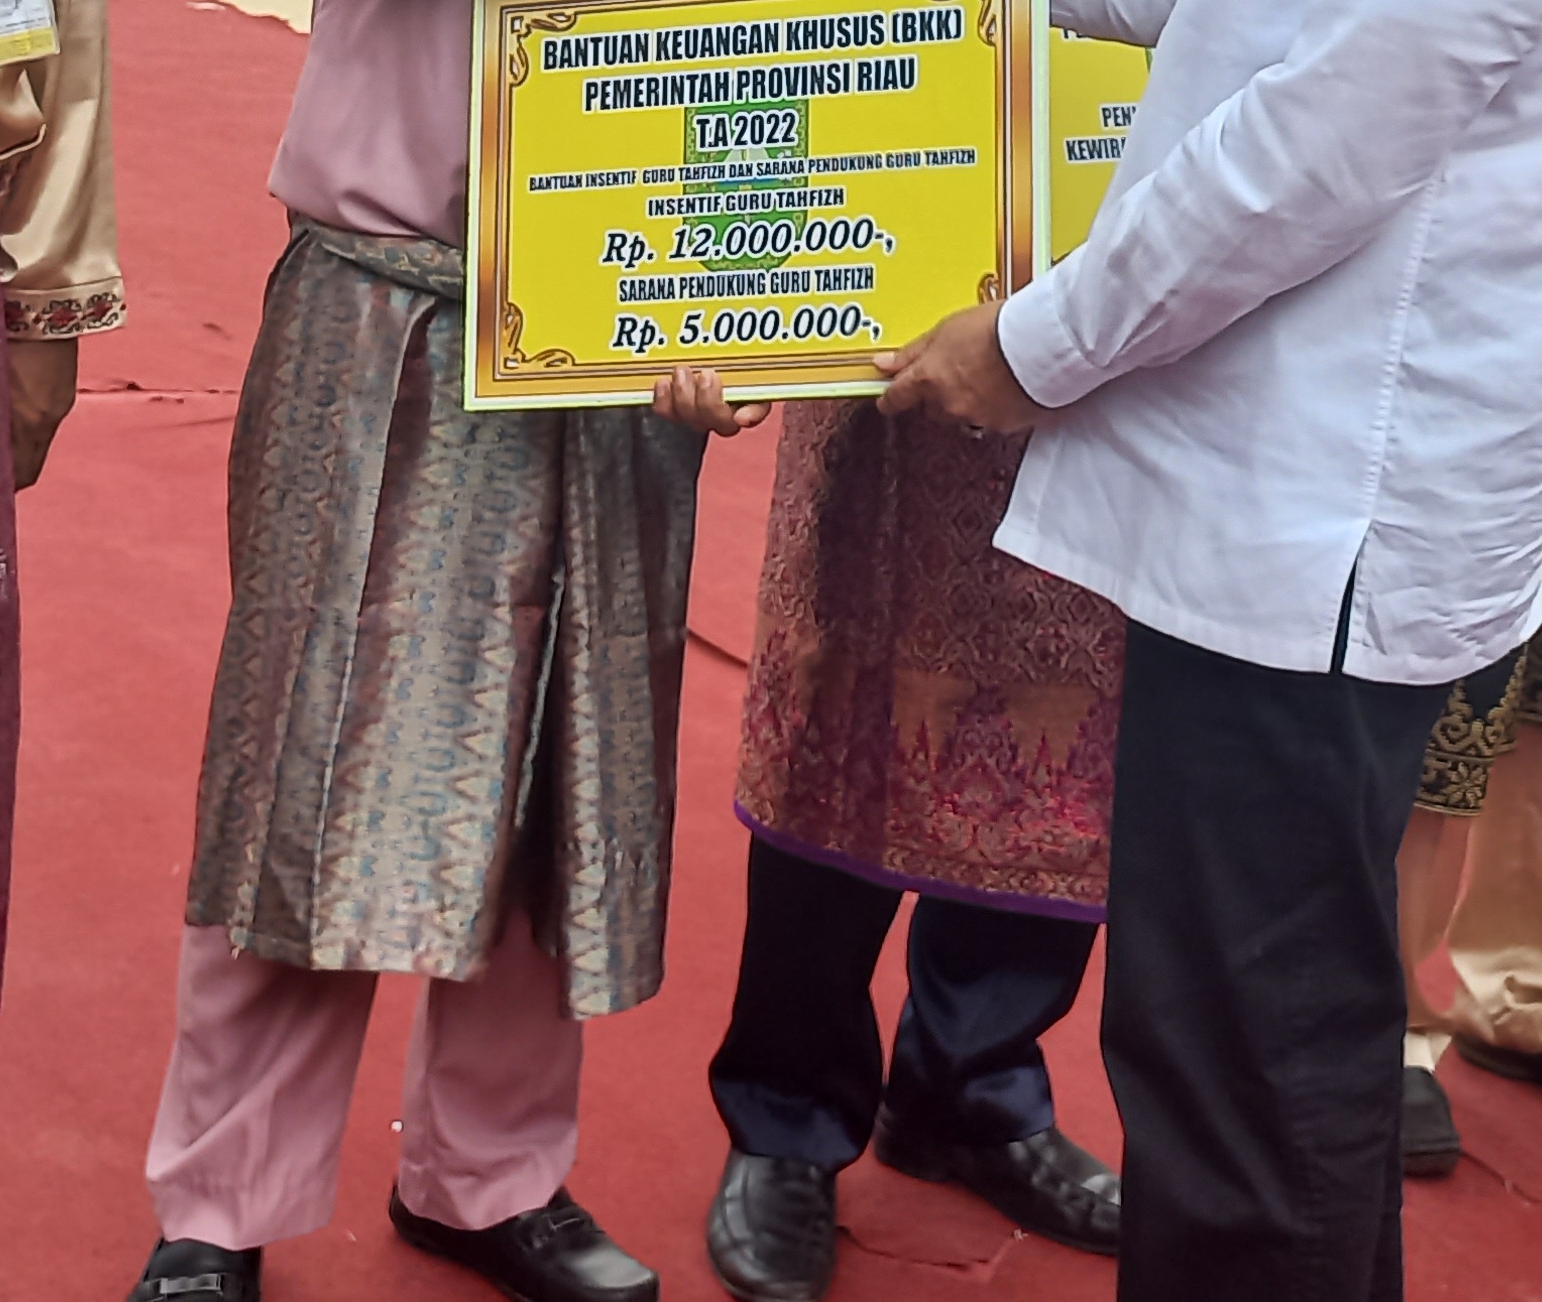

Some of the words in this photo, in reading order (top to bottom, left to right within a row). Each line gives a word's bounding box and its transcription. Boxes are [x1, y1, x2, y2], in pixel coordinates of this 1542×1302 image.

[543, 33, 649, 70] BANTUAN
[656, 22, 779, 61] KEUANGAN
[786, 15, 885, 51] KHUSUS
[892, 9, 962, 43] (BKK)
[585, 71, 729, 111] PEMERINTAH
[736, 62, 850, 100] PROVINSI
[857, 58, 915, 92] RIAU
[734, 112, 796, 146] 2022
[529, 175, 583, 191] BANTUAN
[586, 170, 637, 186] INSENTIF
[642, 168, 674, 183] GURU
[678, 164, 726, 180] TAHFIZH
[729, 164, 753, 178] DAN
[757, 160, 804, 176] SARANA
[808, 153, 882, 173] PENDUKUNG
[886, 151, 920, 168] GURU
[925, 149, 975, 165] TAHFIZH
[648, 196, 721, 216] INSENTIF
[725, 194, 772, 211] GURU
[776, 188, 844, 208] TAHFIZH
[602, 233, 654, 268] Rp.
[669, 218, 894, 259] 12.000.000-,
[619, 277, 675, 302] SARANA
[679, 271, 766, 298] PENDUKUNG
[770, 270, 810, 294] GURU
[815, 266, 874, 292] TAHFIZH
[612, 317, 665, 354] Rp.
[679, 306, 880, 345] 5.000.000-,
